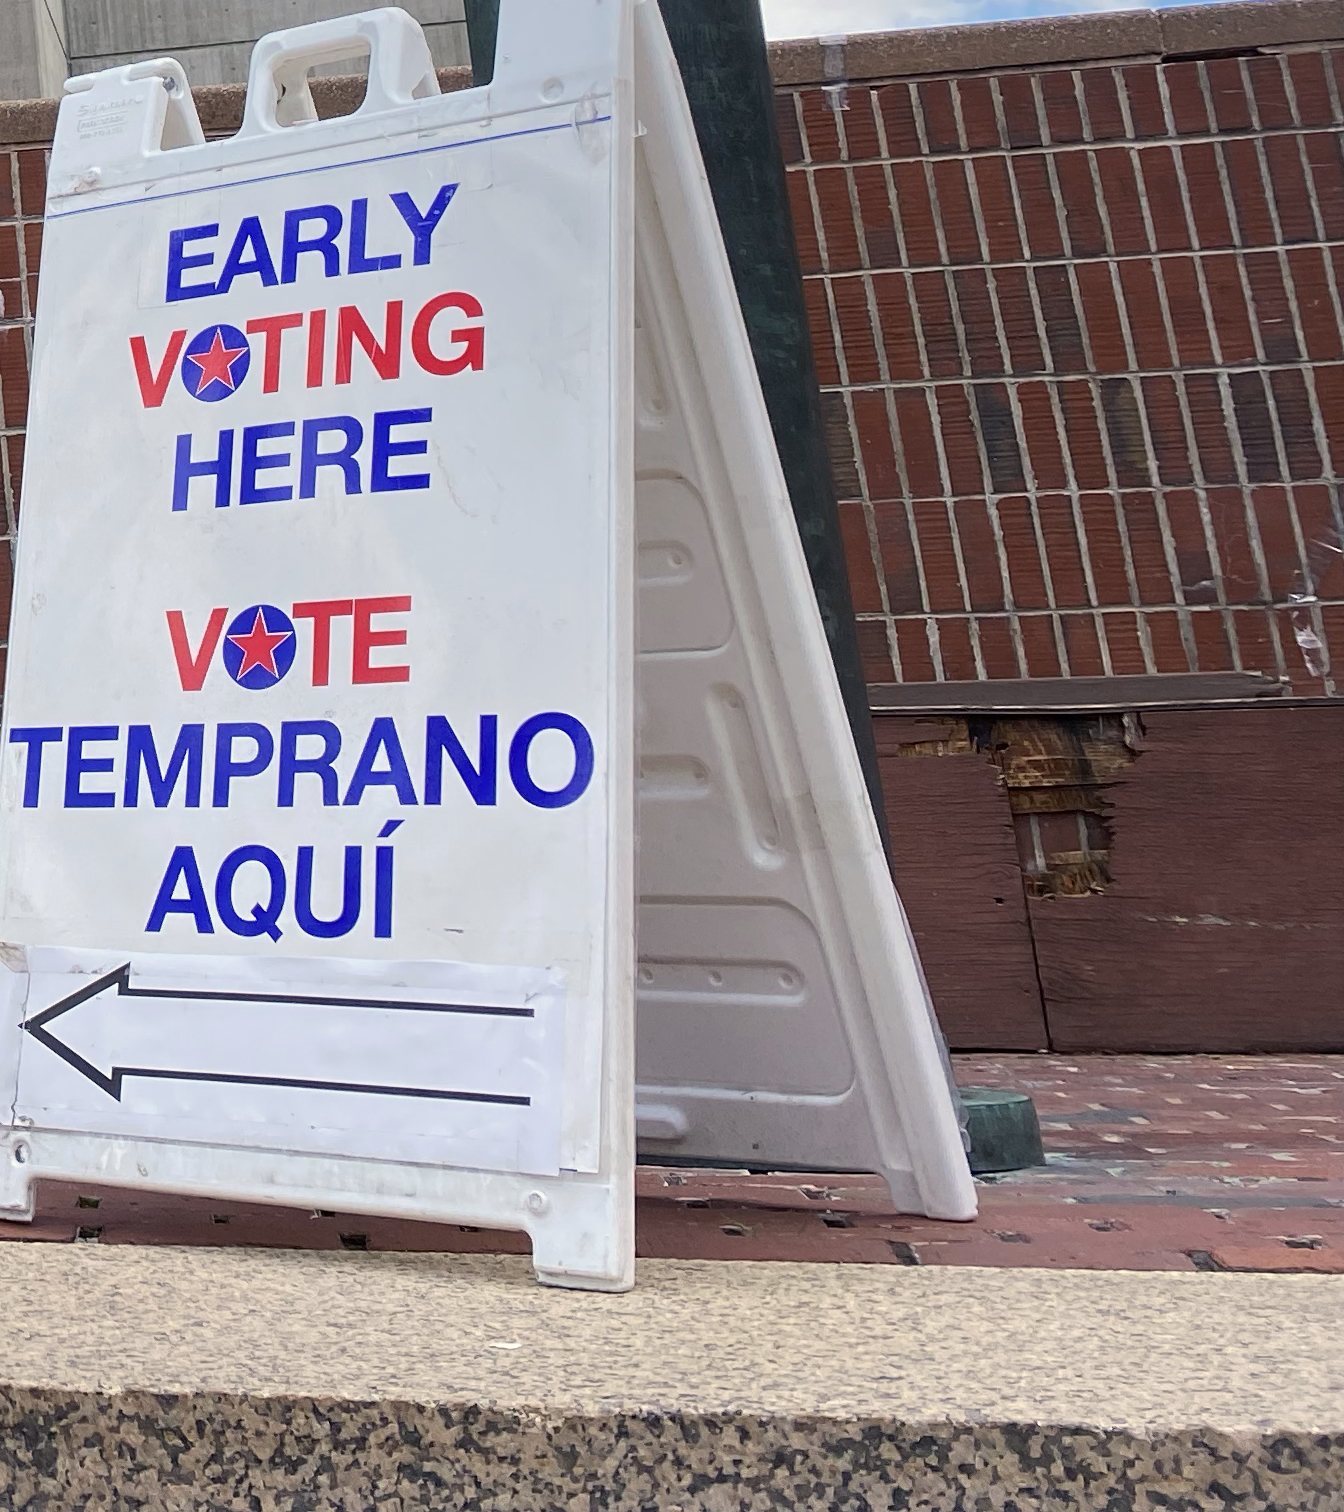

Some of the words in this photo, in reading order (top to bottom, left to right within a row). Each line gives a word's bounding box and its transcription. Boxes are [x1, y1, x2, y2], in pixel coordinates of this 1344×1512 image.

[165, 183, 459, 303] EARLY
[129, 291, 486, 409] VOTING
[172, 407, 433, 512] HERE
[165, 595, 412, 692] VOTE
[9, 711, 596, 809] TEMPRANO
[145, 820, 405, 943] AQUÍ
